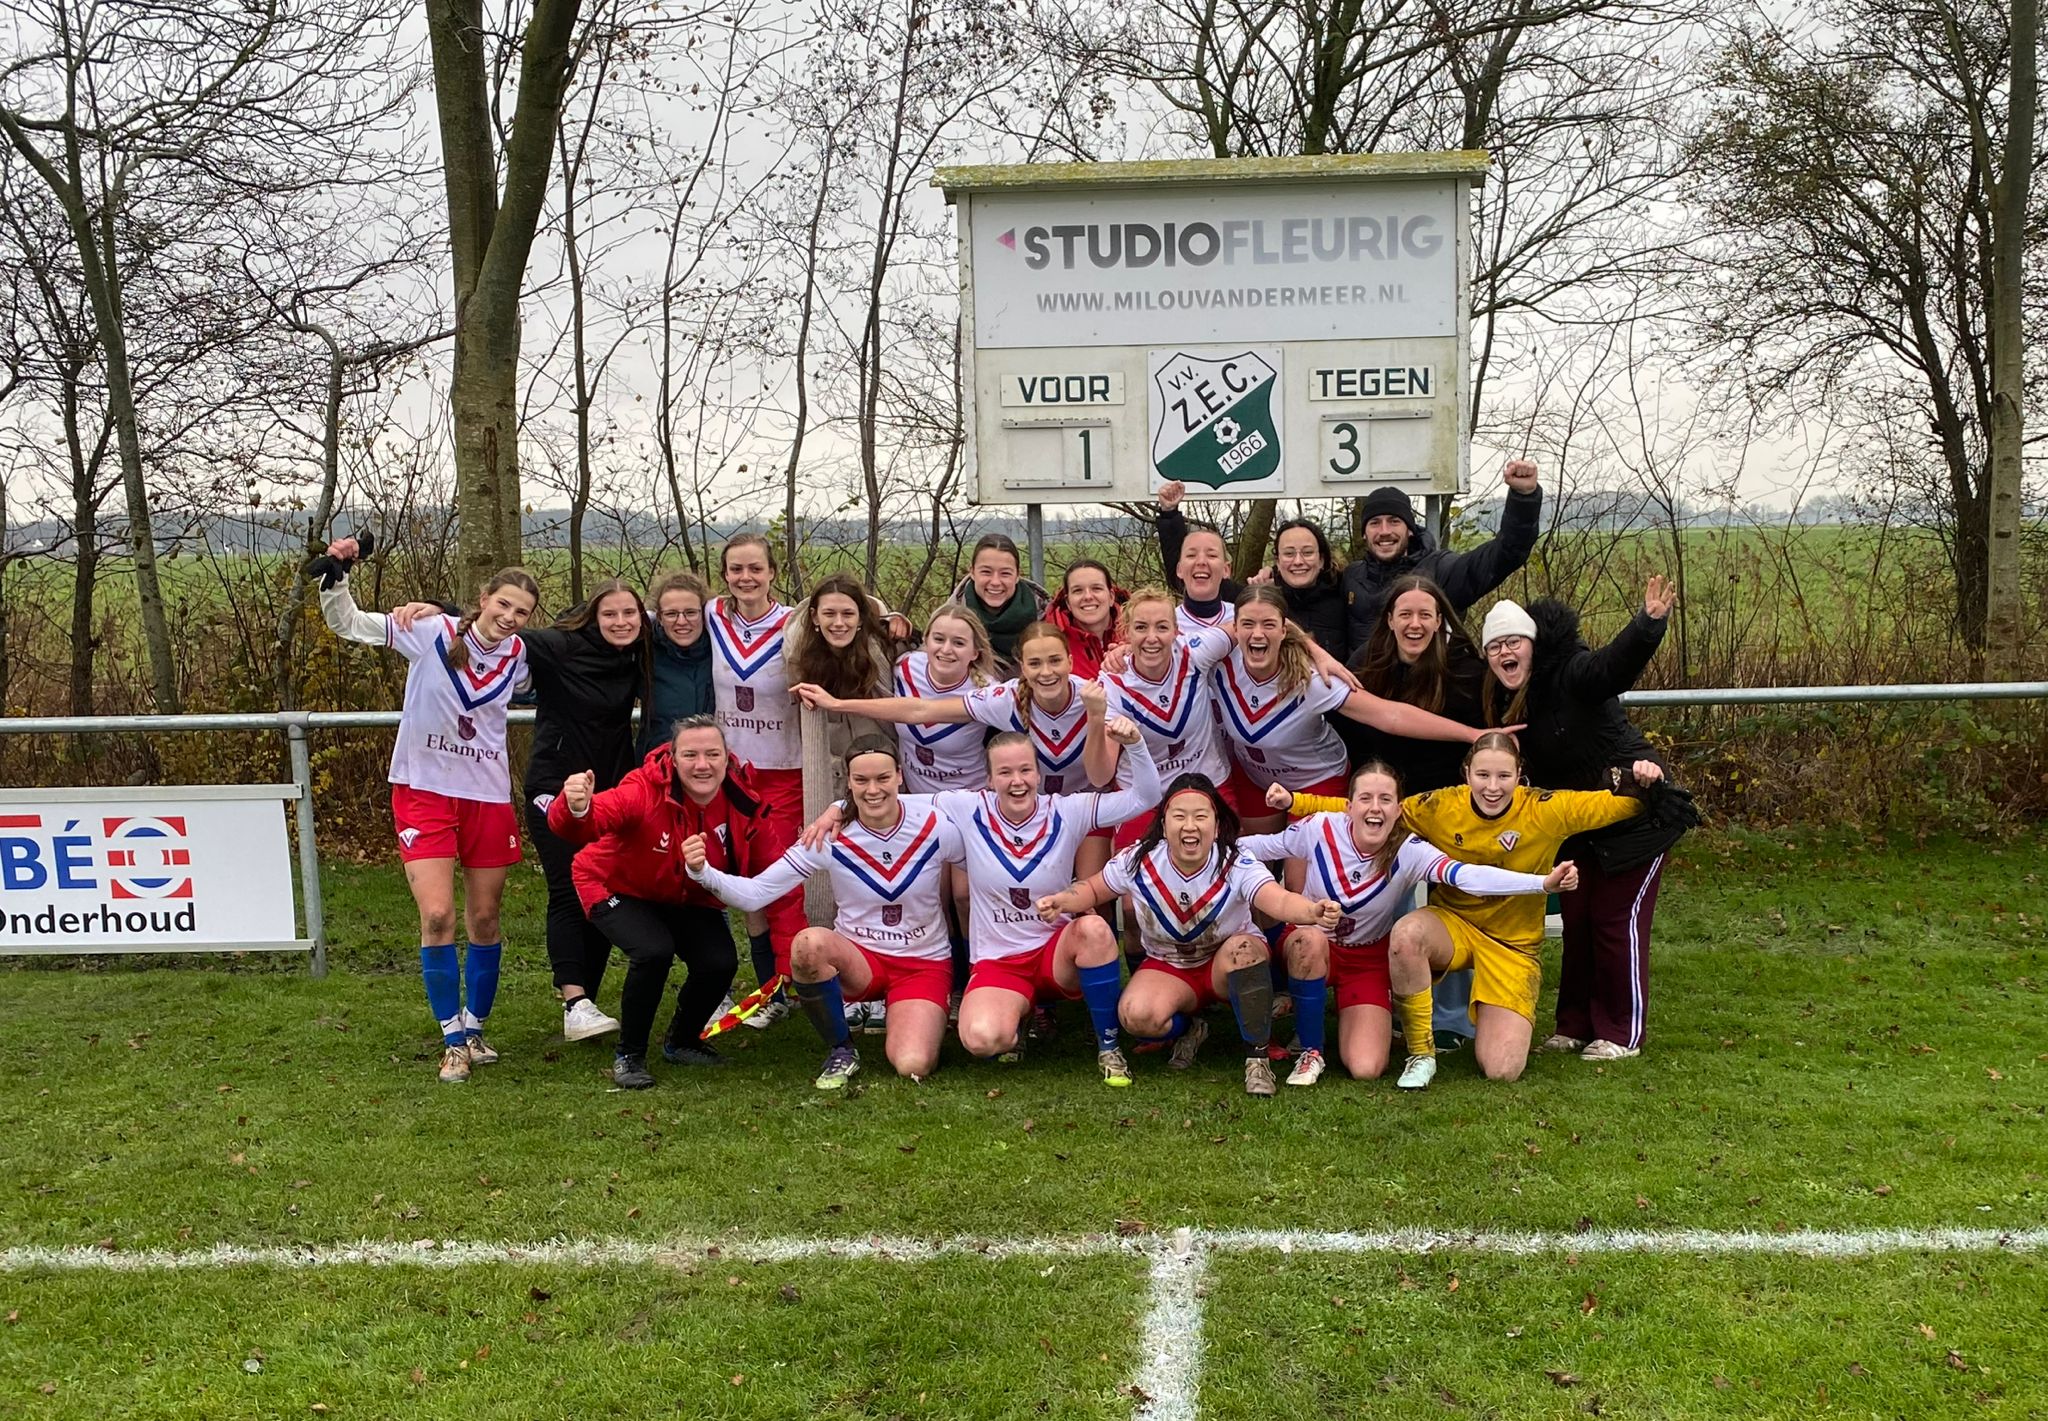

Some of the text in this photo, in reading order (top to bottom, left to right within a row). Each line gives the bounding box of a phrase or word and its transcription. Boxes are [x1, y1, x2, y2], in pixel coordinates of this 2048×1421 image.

[1024, 214, 1444, 270] STUDIOFLEURIG
[1037, 284, 1411, 313] WWW.MILOUVANDERMEER.NL
[1018, 375, 1110, 403] VOOR
[1168, 366, 1199, 391] V.V.
[1316, 367, 1429, 397] TEGEN
[1171, 363, 1258, 433] Z.E.C.
[1079, 429, 1091, 480] 1
[1221, 434, 1262, 470] 1966
[1329, 422, 1361, 475] 3
[717, 710, 784, 735] Ekamper
[426, 733, 500, 763] Ekamper
[1156, 749, 1204, 771] amper
[0, 902, 197, 934] nderhoud
[992, 908, 1043, 924] Ekam
